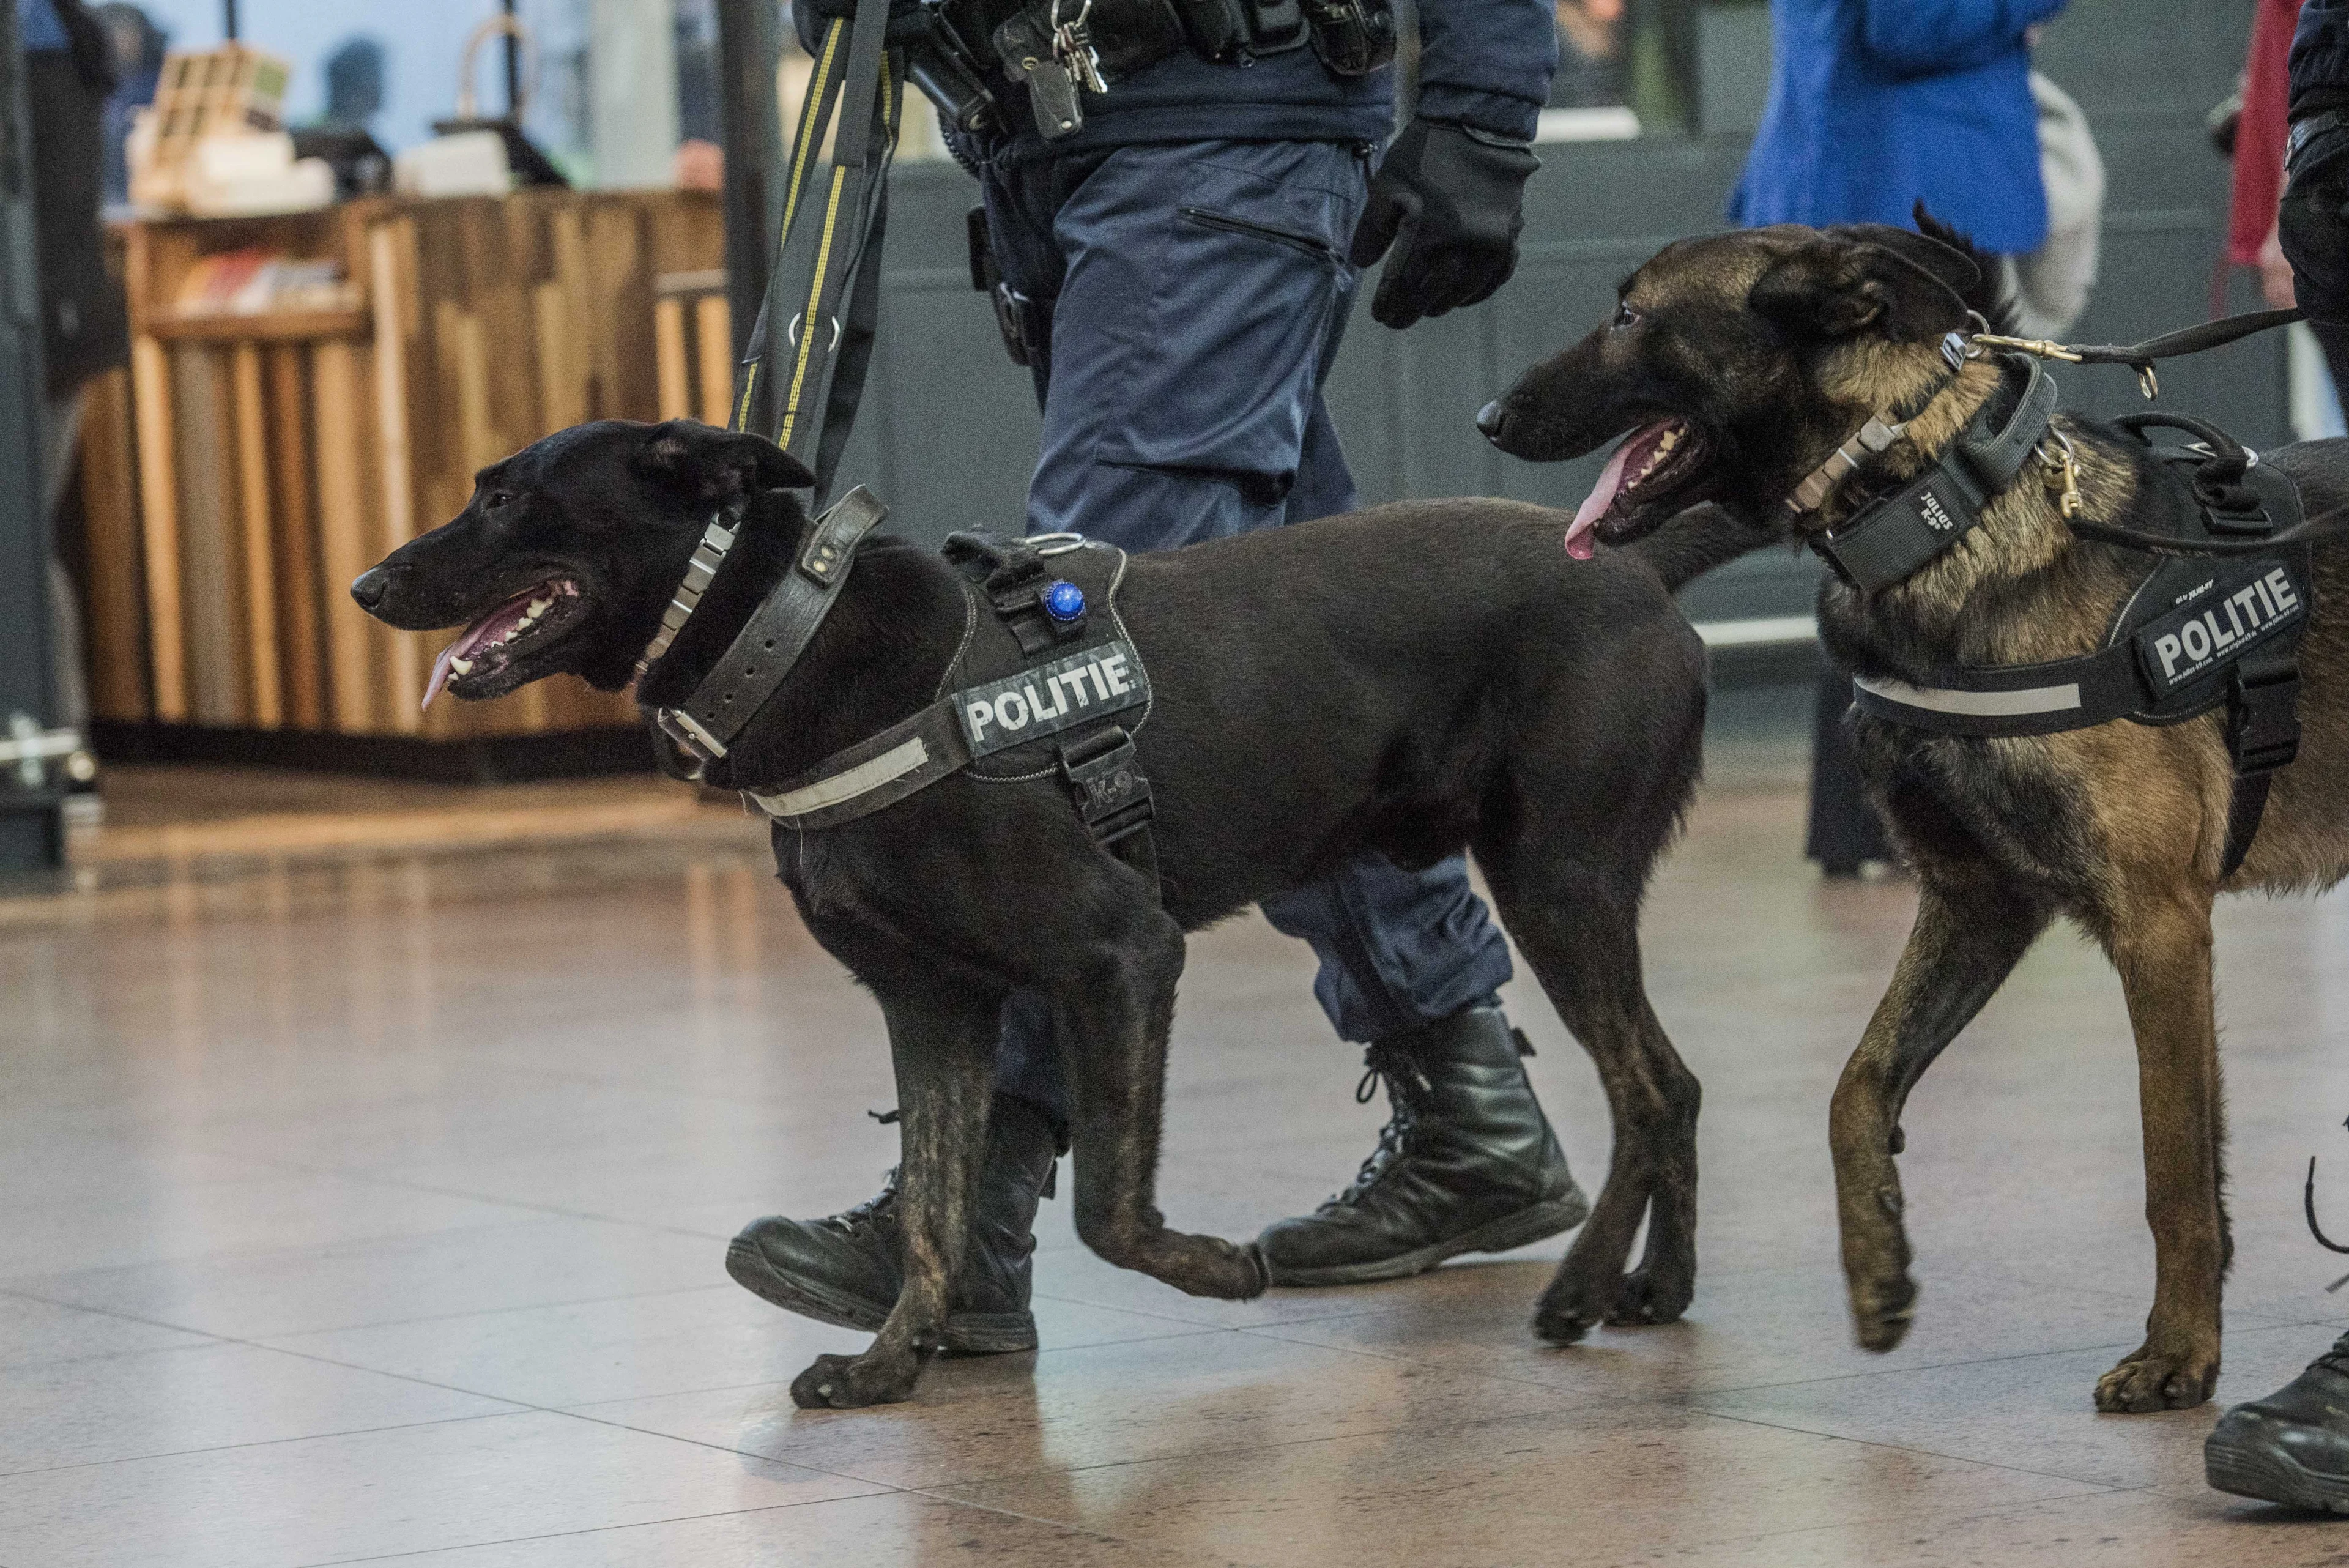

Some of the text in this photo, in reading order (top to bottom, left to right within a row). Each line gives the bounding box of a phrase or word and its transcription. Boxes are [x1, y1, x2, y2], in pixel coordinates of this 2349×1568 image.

[1921, 492, 1953, 530] JULIUS
[2154, 567, 2298, 678] POLITIE
[967, 653, 1130, 743] POLITIE
